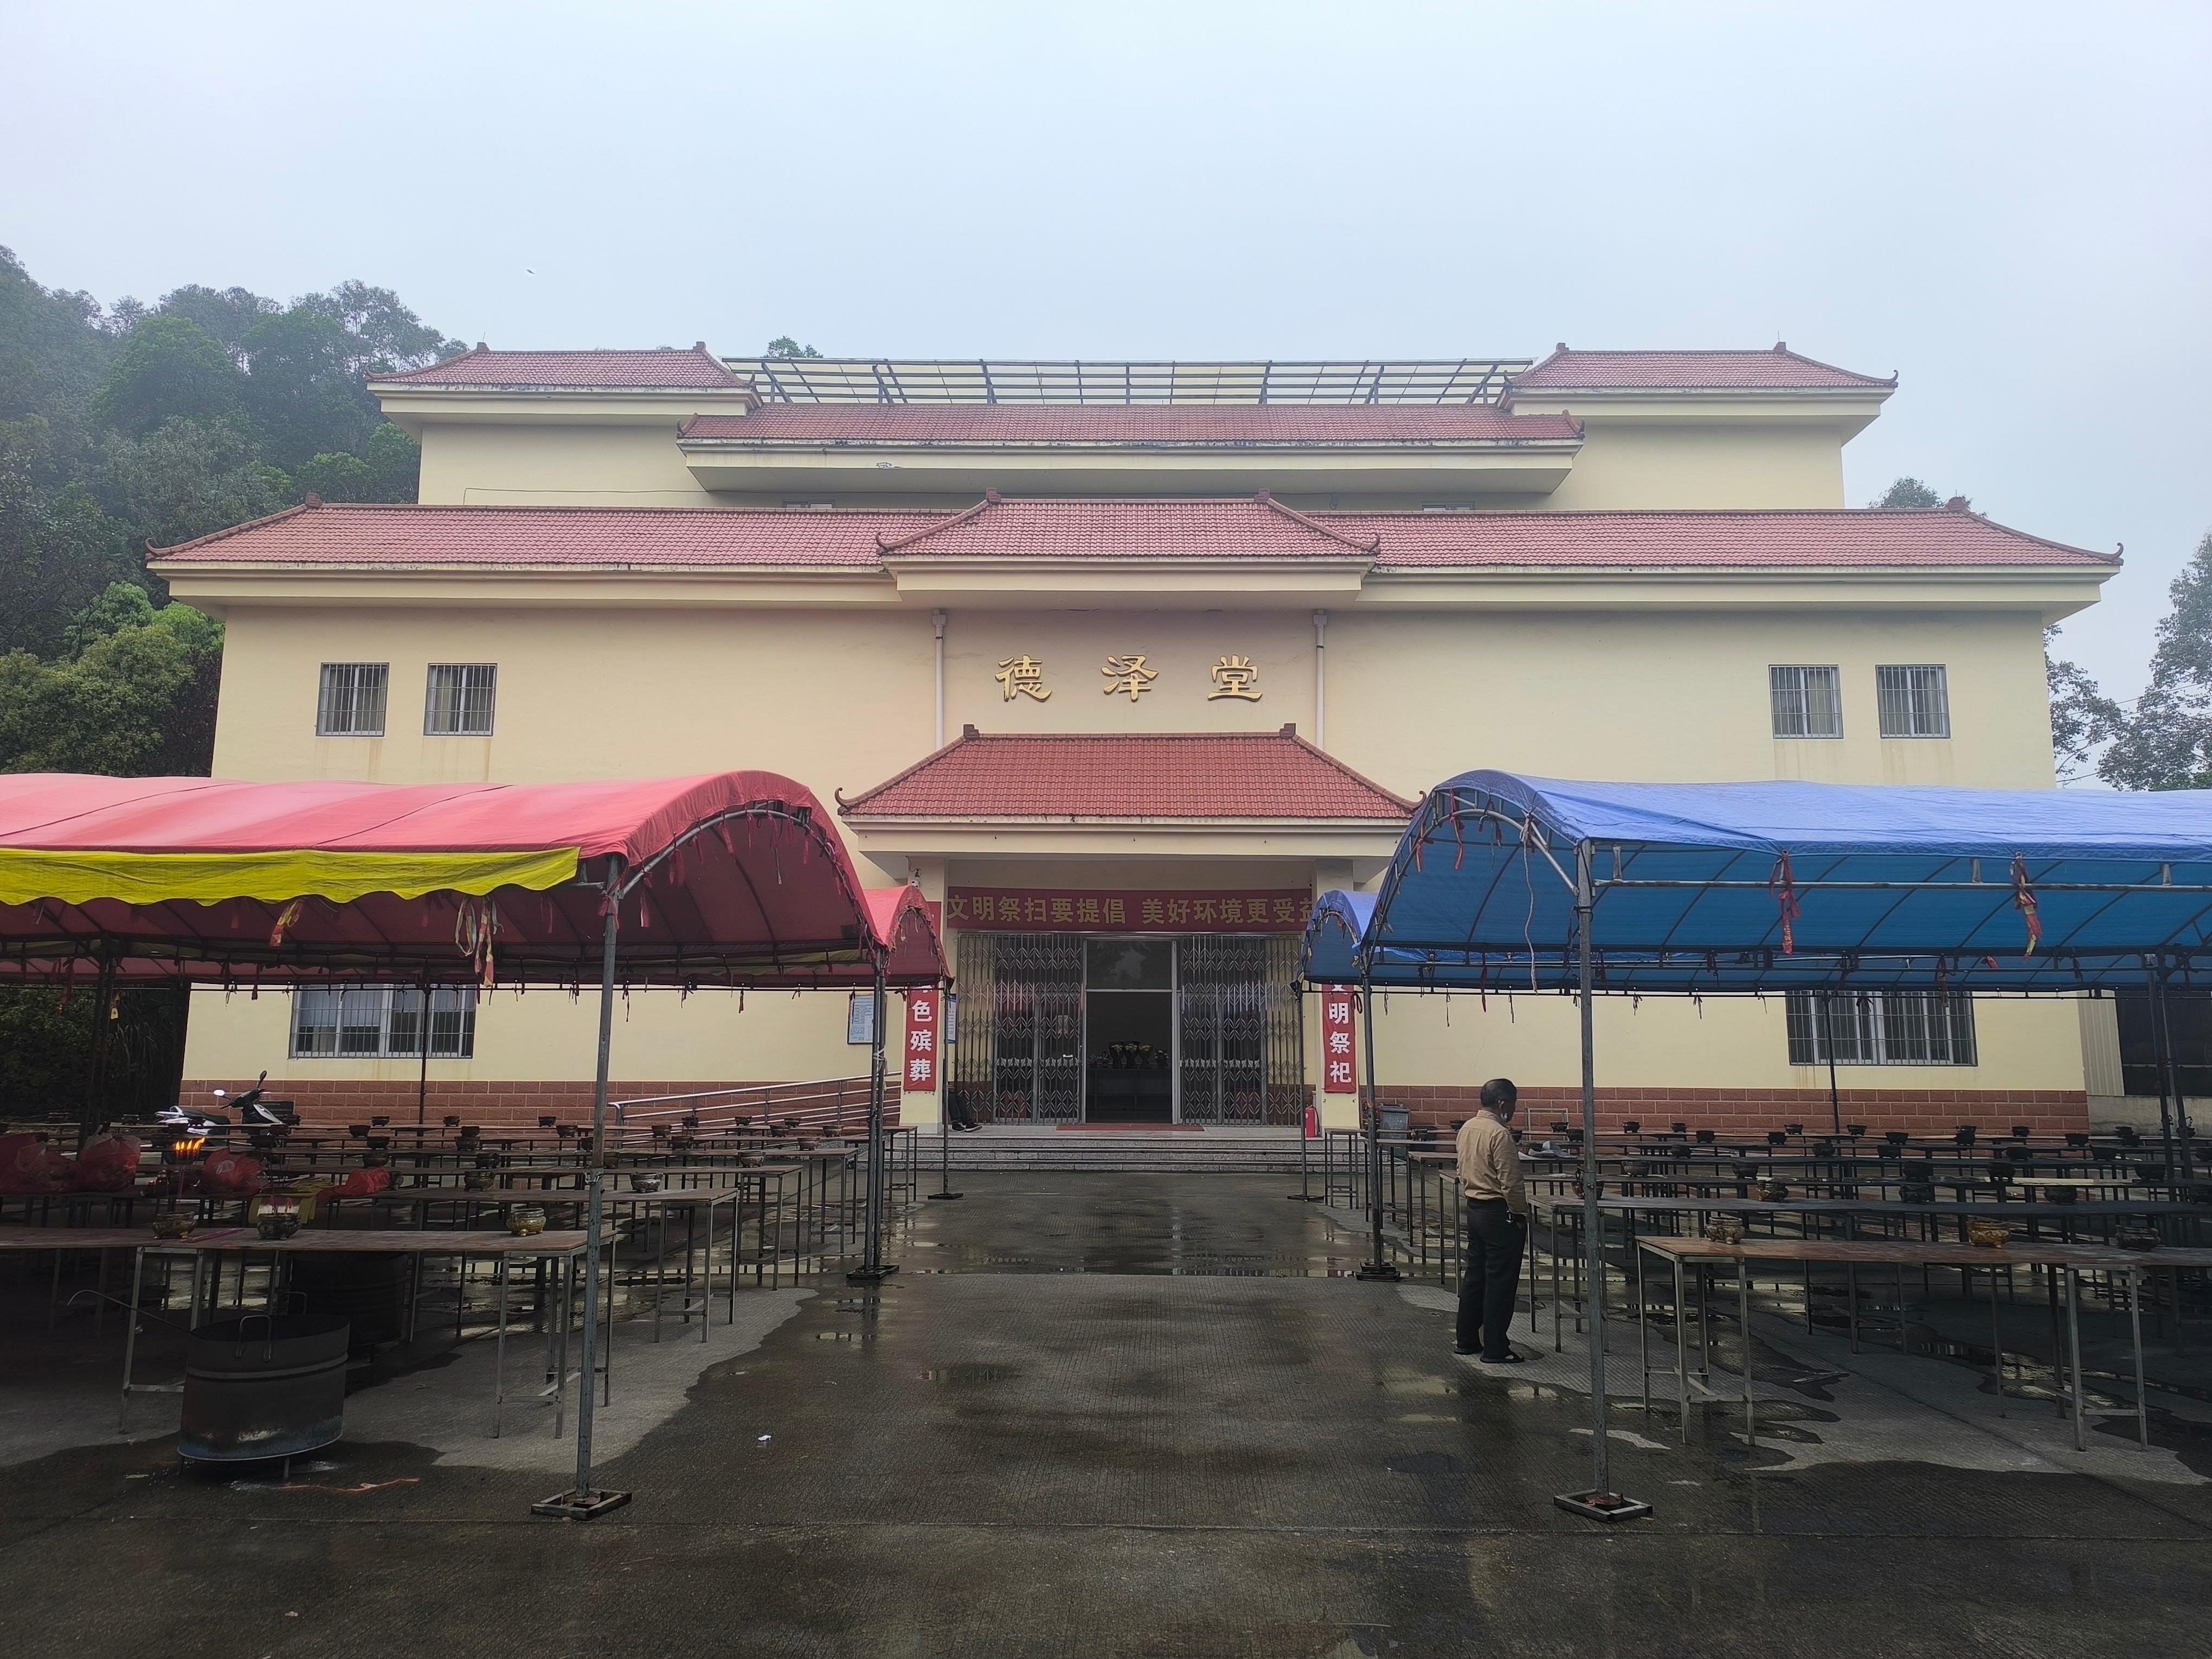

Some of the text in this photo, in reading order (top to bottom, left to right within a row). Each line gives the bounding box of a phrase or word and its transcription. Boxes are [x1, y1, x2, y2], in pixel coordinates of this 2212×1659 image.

[994, 654, 1263, 703] 德泽堂
[947, 894, 1126, 924] 文明祭扫要提倡
[909, 985, 933, 1082] 色殡葬
